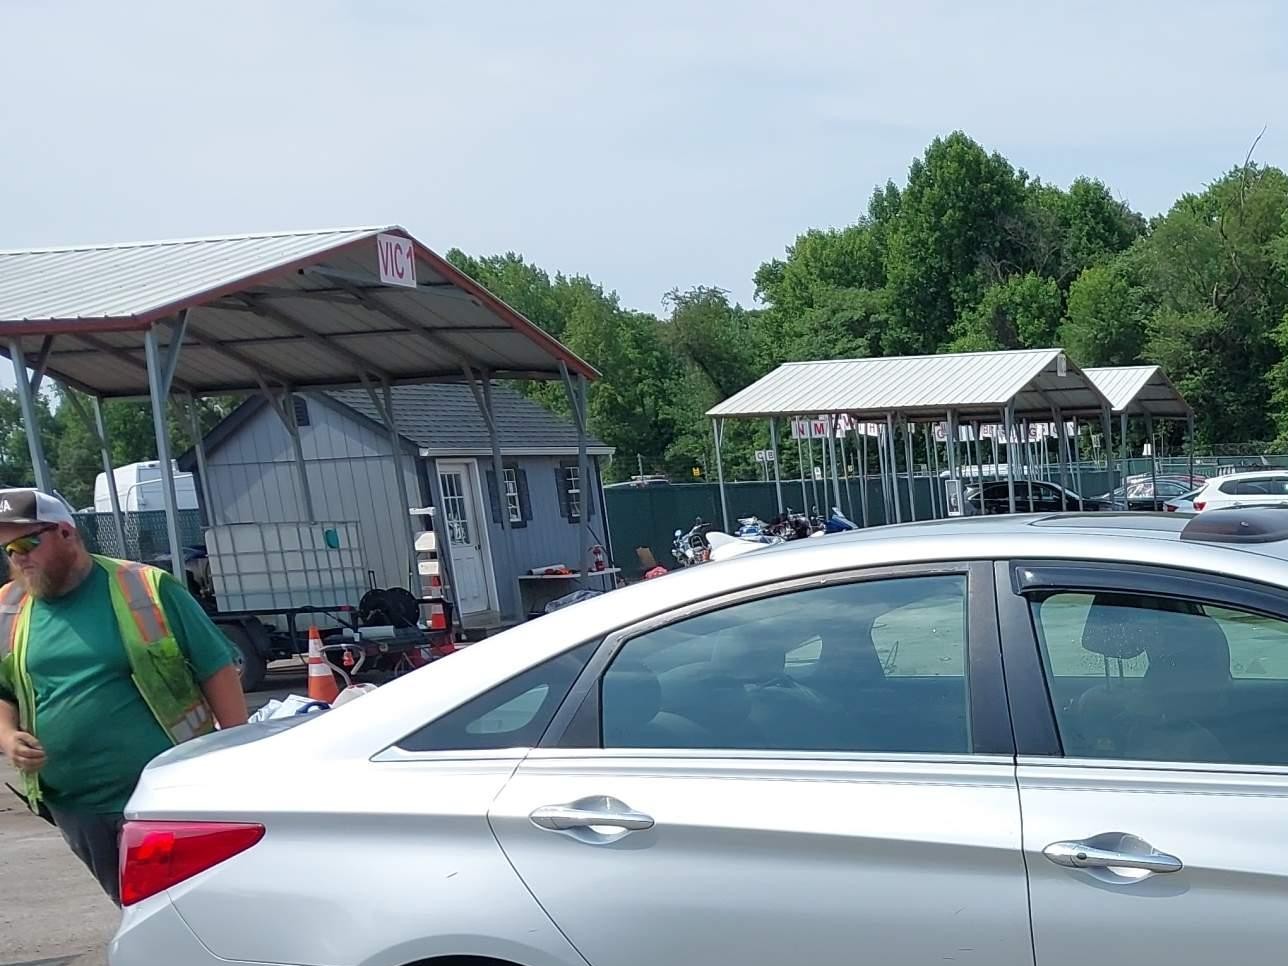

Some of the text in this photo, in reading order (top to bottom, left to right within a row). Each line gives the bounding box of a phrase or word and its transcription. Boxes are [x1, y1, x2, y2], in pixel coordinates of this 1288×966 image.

[378, 240, 415, 281] VIC 1
[813, 422, 825, 435] M
